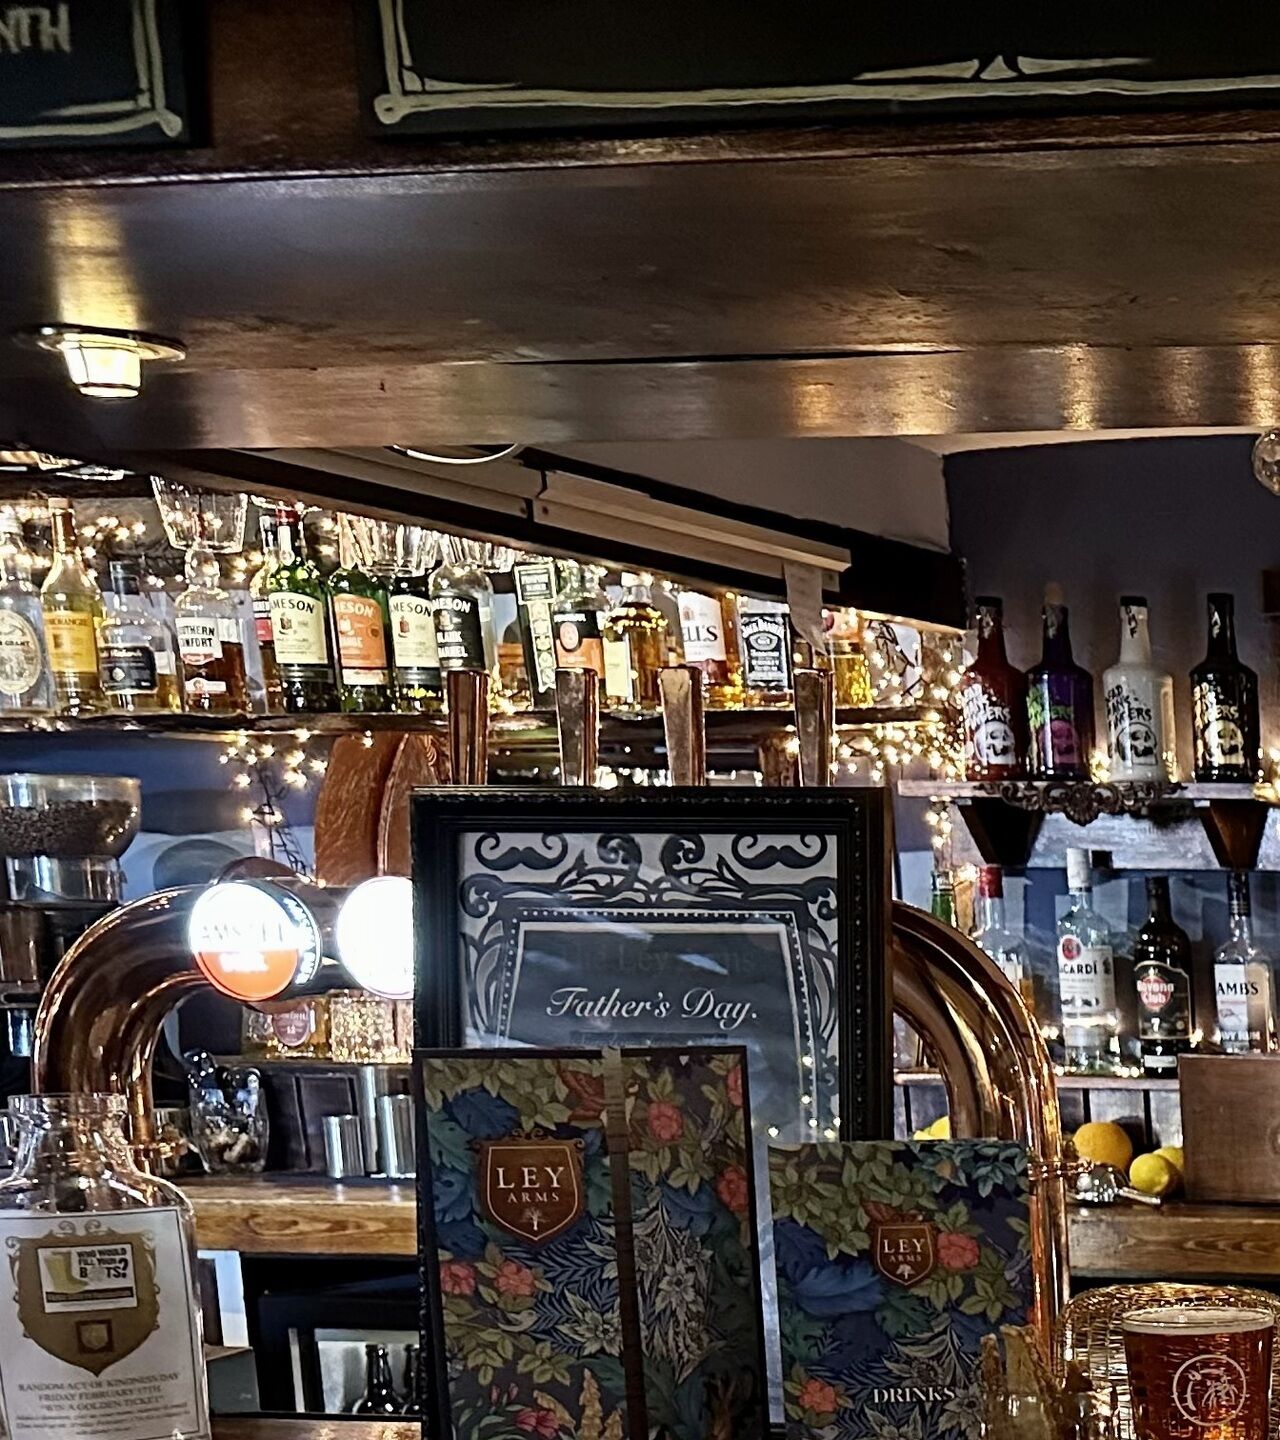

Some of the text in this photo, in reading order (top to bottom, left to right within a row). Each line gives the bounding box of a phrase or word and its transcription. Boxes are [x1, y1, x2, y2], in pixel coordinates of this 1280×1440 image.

[546, 986, 759, 1031] Father's Day.
[497, 1165, 565, 1191] LEY
[507, 1190, 560, 1204] ARMS
[883, 1236, 925, 1255] LEY
[888, 1254, 924, 1263] ARMS
[873, 1387, 956, 1404] DRINKS
